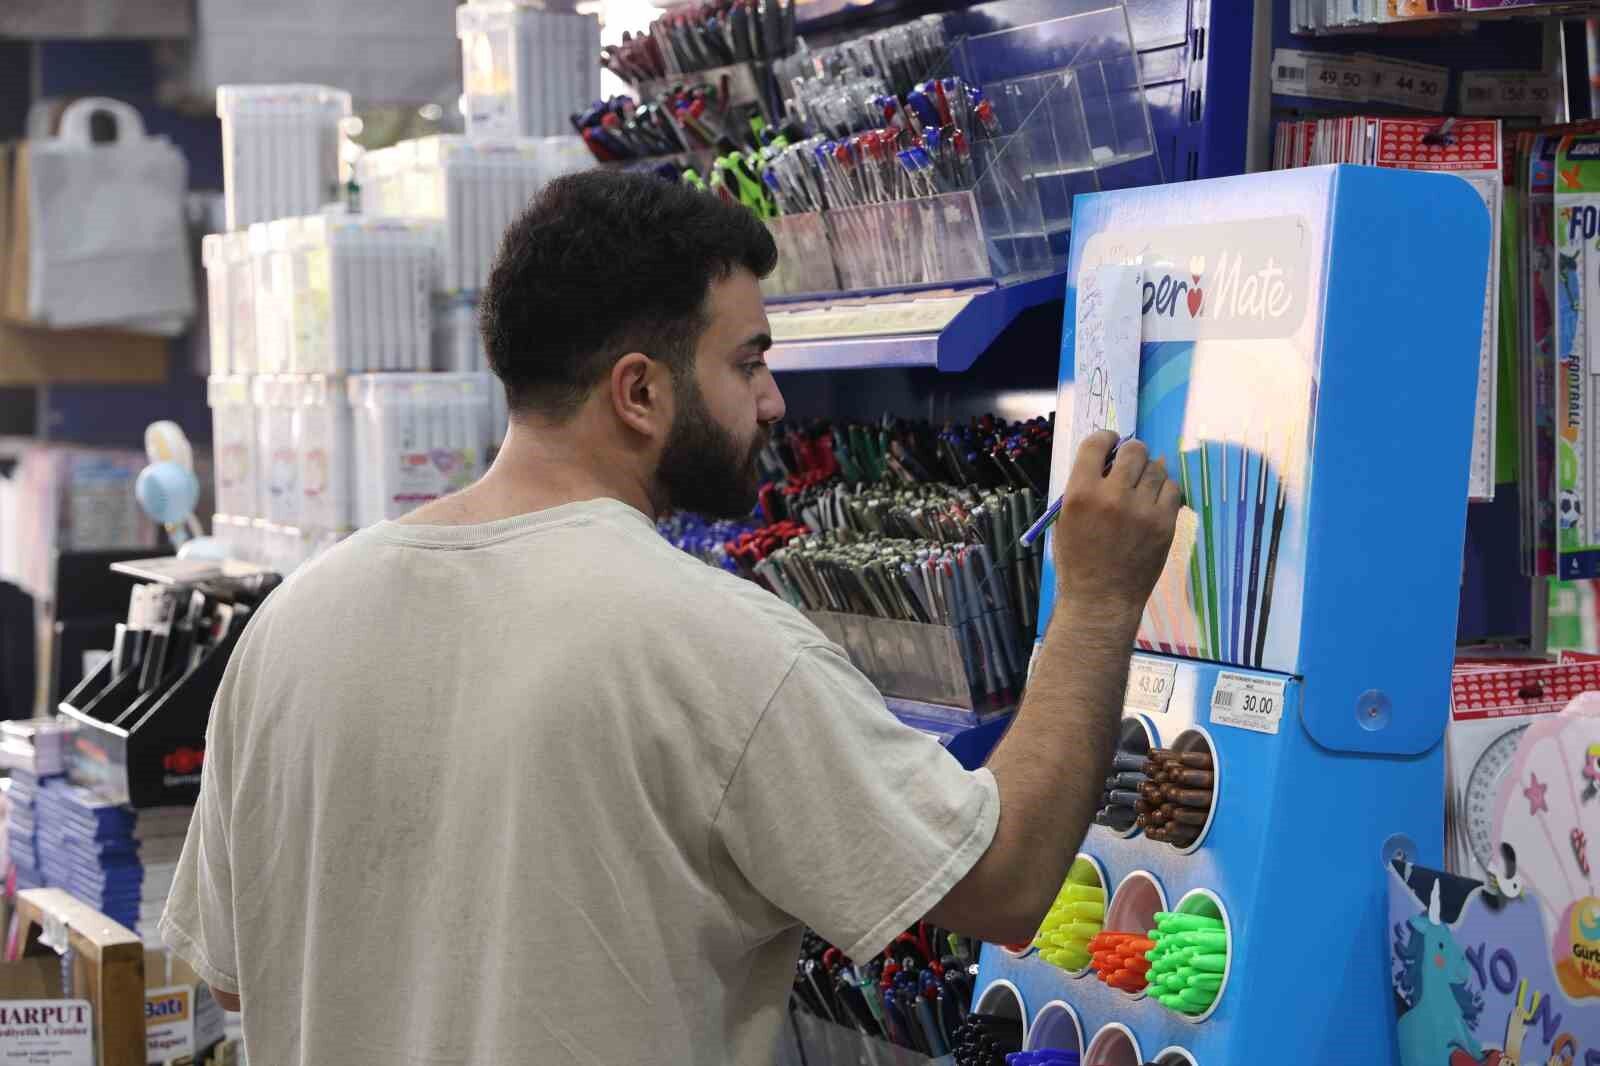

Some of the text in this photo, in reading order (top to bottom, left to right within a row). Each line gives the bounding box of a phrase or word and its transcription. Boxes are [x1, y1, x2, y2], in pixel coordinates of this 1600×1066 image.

[1569, 205, 1600, 240] FO
[1209, 251, 1292, 319] Mate
[1568, 354, 1580, 428] FOOTBALL
[1243, 695, 1273, 714] 30.00
